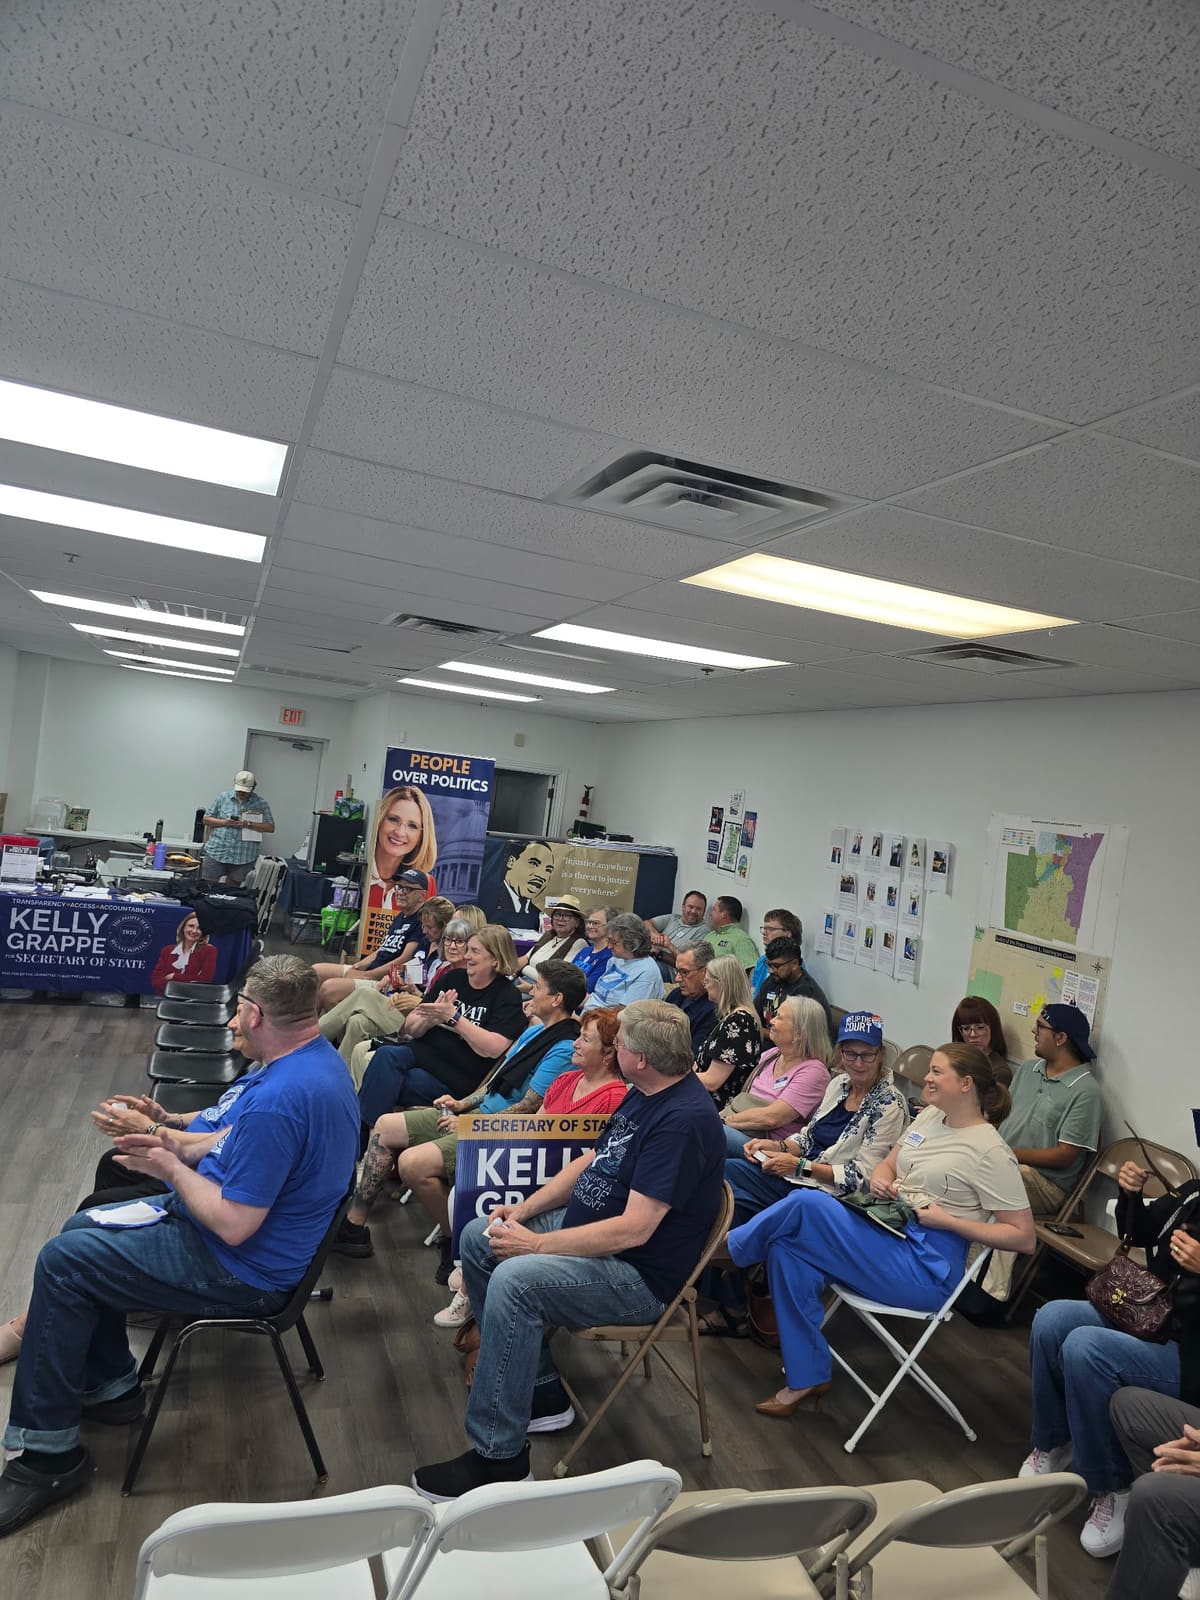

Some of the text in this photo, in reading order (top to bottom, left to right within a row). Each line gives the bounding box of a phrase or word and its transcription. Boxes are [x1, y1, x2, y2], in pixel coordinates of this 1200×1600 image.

[283, 709, 303, 722] EXIT
[409, 753, 471, 775] PEOPLE
[392, 769, 489, 793] OVER POLITICS
[597, 862, 633, 872] anywhere
[561, 870, 568, 878] is
[574, 871, 597, 881] threat
[606, 876, 631, 885] justice
[12, 898, 156, 914] TRANSPARENCY ACCESS ACCOUNTABILITY
[9, 907, 109, 934] KELLY
[6, 932, 107, 954] GRAPPE
[15, 952, 88, 966] SECRETARY
[89, 956, 107, 967] OF
[108, 958, 146, 969] STATE
[844, 1022, 872, 1033] COURT
[472, 1119, 553, 1132] SECRETARY
[559, 1119, 578, 1132] OF
[582, 1119, 609, 1132] STA
[590, 1186, 610, 1201] OF
